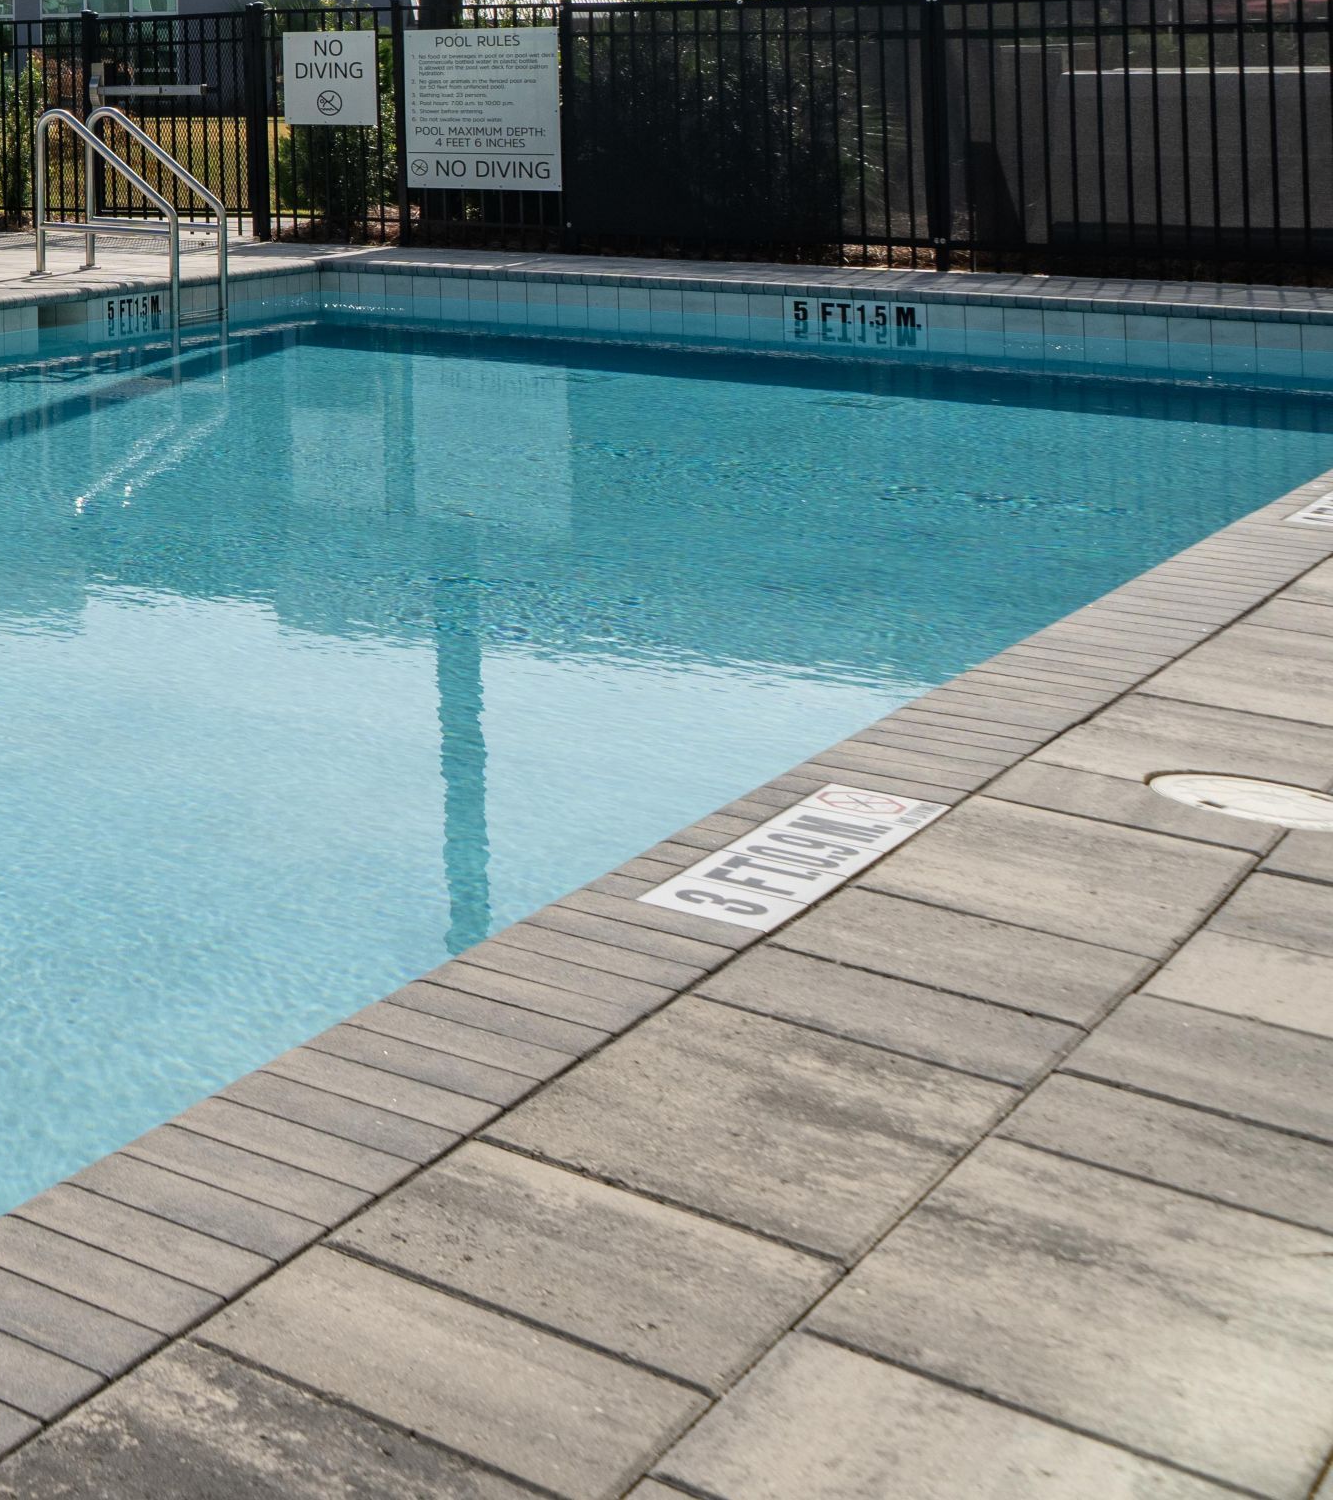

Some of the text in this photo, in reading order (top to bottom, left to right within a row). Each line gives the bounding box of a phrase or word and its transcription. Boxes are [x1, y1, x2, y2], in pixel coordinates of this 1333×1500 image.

[314, 39, 343, 56] NO
[435, 34, 520, 47] POOL RULES
[295, 62, 363, 79] DIVING
[414, 126, 546, 136] POOL MAXIMUM DEPTH:
[435, 137, 525, 147] 4 FEET 6 INCHES
[435, 159, 550, 178] NO DIVING
[108, 301, 114, 320] 5
[135, 297, 147, 317] 1.5
[151, 294, 161, 315] M.
[793, 301, 921, 328] 5 FT. 1.5 M.
[674, 815, 894, 916] 3 FT. 0.9 M.
